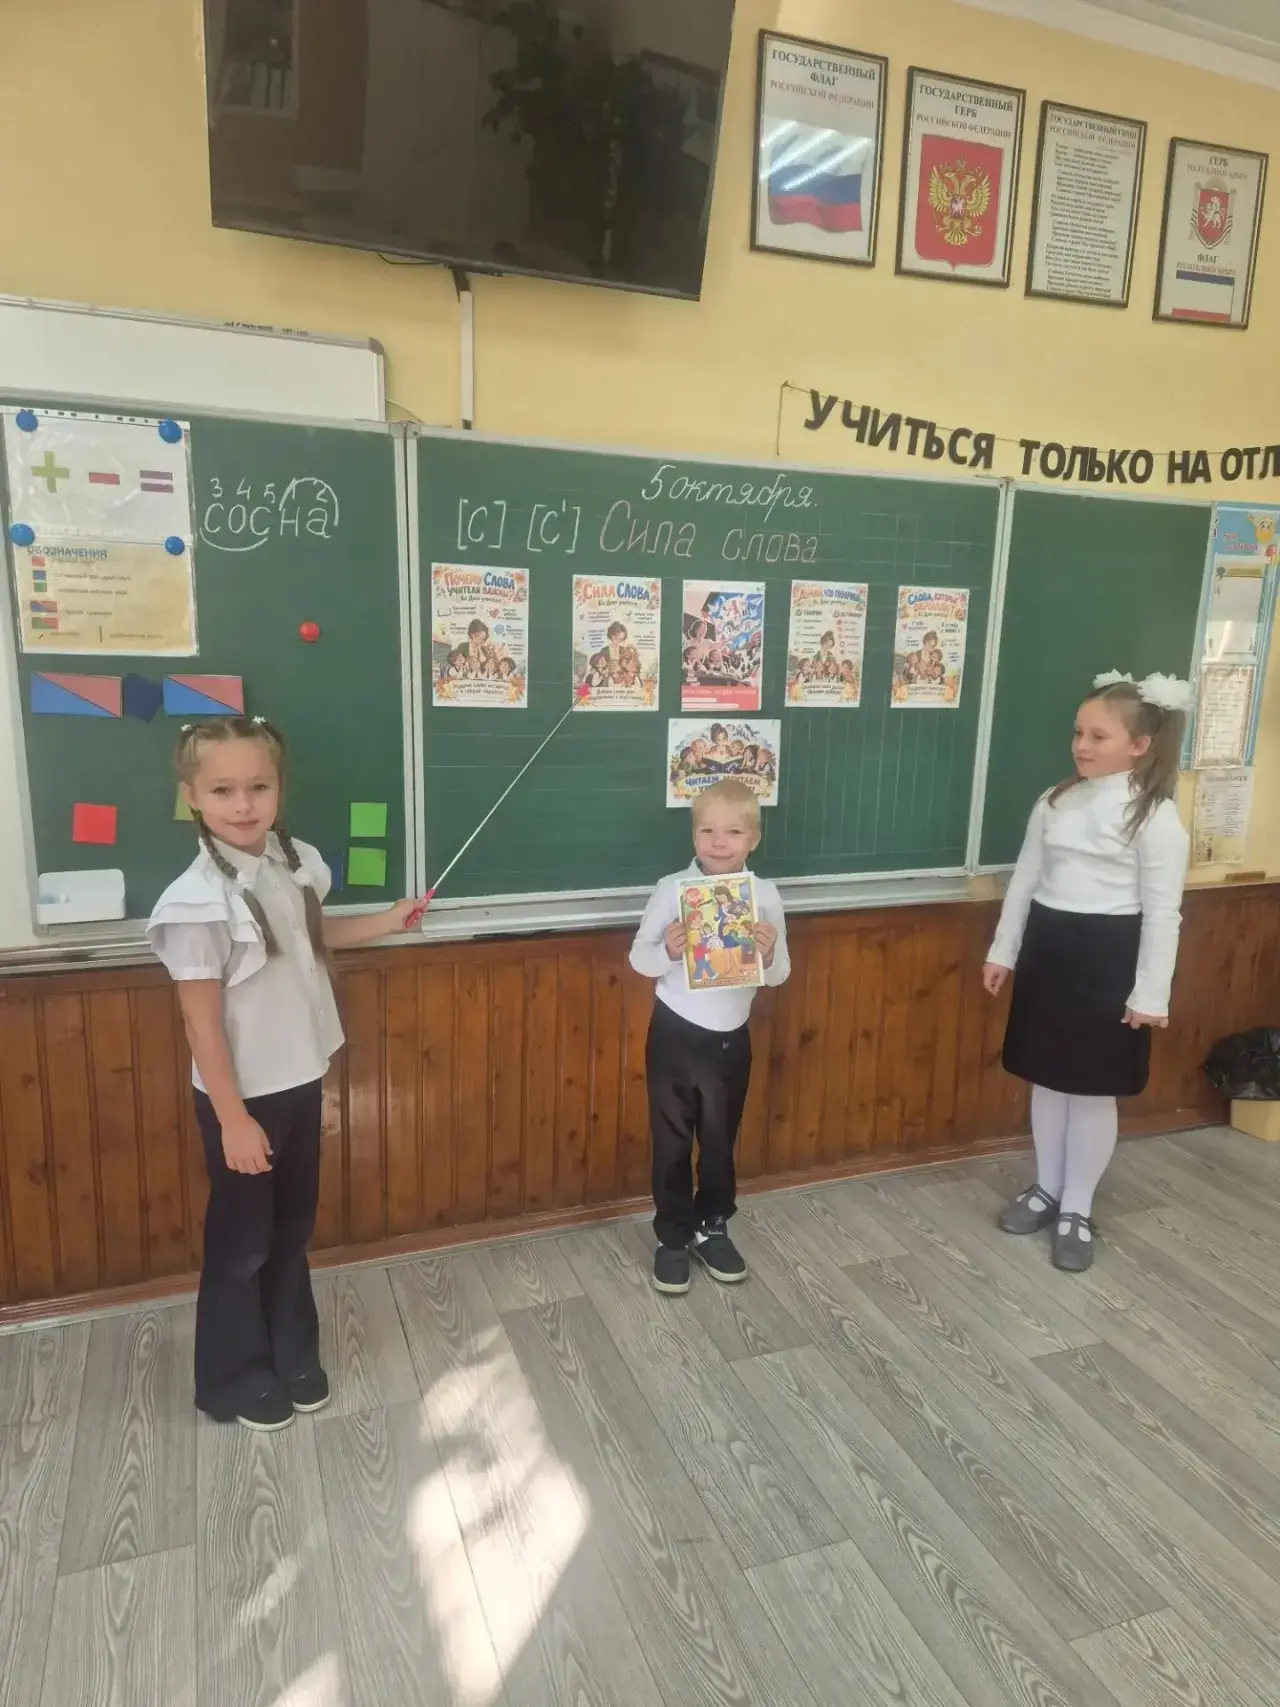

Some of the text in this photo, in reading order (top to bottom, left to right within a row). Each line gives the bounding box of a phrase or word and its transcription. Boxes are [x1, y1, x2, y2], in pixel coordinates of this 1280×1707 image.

[772, 49, 876, 81] ГОСУДАРСТВЕННЫЙ
[810, 72, 838, 87] ФЛАГ
[770, 80, 875, 109] РОССИЙСКОЙ ФЕДЕРАЦИИ
[920, 84, 1014, 112] ГОСУДАРСТВЕННЫЙ
[954, 105, 978, 118] ГЕРБ
[917, 113, 1012, 139] РОССИЙСКОЙ ФЕДЕРАЦИИ
[1208, 155, 1229, 167] ГЕРБ
[1197, 253, 1219, 264] ФЛАГ
[804, 389, 996, 470] УЧИТЬСЯ
[1019, 438, 1154, 484] ТОЛЬКО
[1167, 450, 1212, 484] НА
[210, 477, 223, 498] 3
[236, 476, 251, 500] 4
[264, 483, 276, 504] 5
[641, 464, 677, 500] 5
[600, 500, 696, 557] Сила
[721, 528, 819, 564] слова
[27, 546, 108, 559] ОБОЗНАЧЕНИЯ
